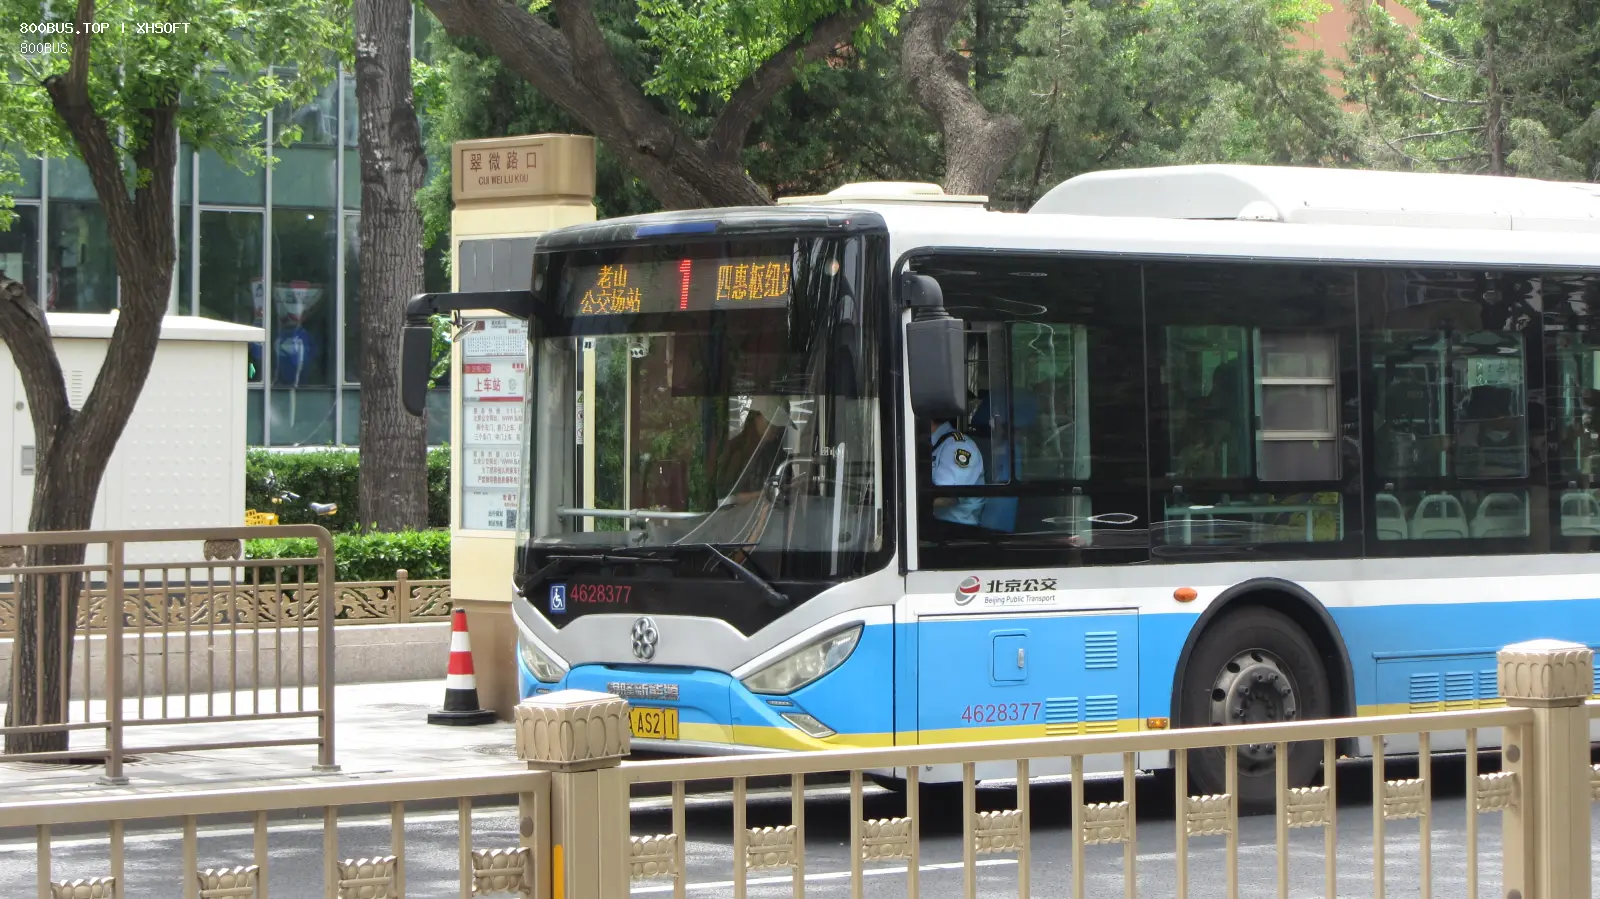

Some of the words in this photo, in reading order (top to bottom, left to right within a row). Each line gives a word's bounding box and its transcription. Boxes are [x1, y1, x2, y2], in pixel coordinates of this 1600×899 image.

[470, 151, 537, 173] 翠微路口
[478, 176, 490, 185] CUI
[491, 175, 503, 185] WEI
[504, 175, 514, 184] LU
[514, 174, 529, 183] KOU
[597, 263, 628, 289] 老山
[679, 259, 691, 310] 1
[581, 287, 642, 314] 公交场站
[474, 377, 501, 392] 上车站
[570, 584, 632, 604] 4628377
[985, 578, 1057, 594] 北京公交
[984, 596, 1005, 605] Beijing
[1006, 595, 1024, 604] Public
[1025, 594, 1055, 604] Transport
[961, 702, 1041, 723] 4628377
